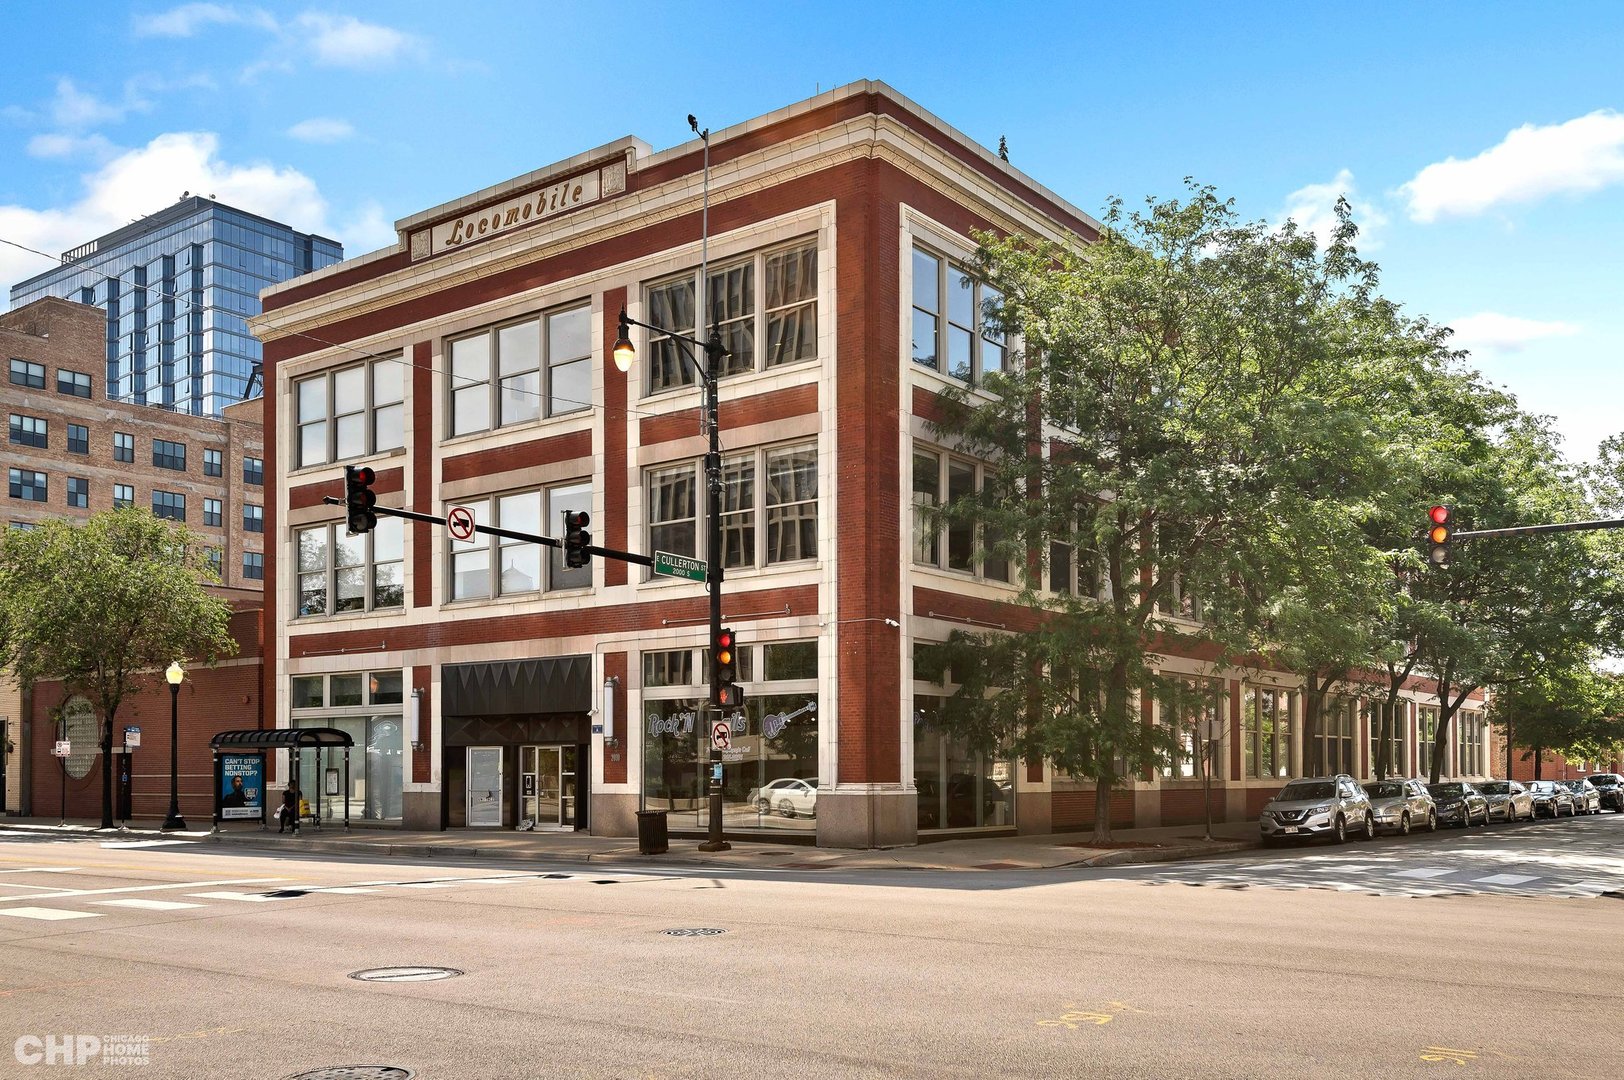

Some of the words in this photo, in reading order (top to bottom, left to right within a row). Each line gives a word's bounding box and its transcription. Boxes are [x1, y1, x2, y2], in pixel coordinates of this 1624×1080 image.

[445, 183, 583, 246] Locomobile
[661, 555, 700, 571] CULLERTON
[672, 567, 686, 576] 2000
